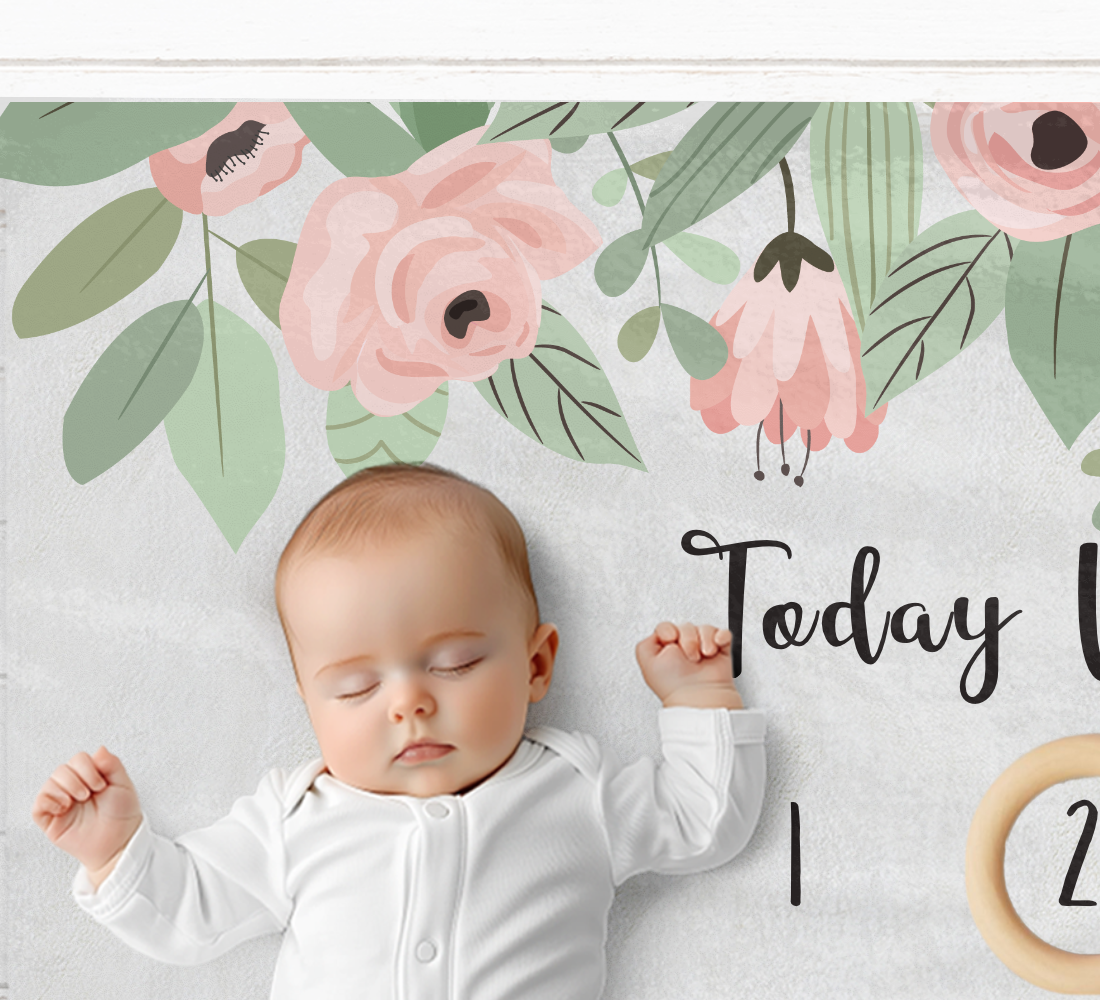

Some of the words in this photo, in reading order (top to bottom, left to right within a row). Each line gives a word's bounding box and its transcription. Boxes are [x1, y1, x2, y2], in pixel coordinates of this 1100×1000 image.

[680, 528, 1024, 706] Today
[789, 800, 803, 908] 1
[1057, 798, 1100, 908] 2
